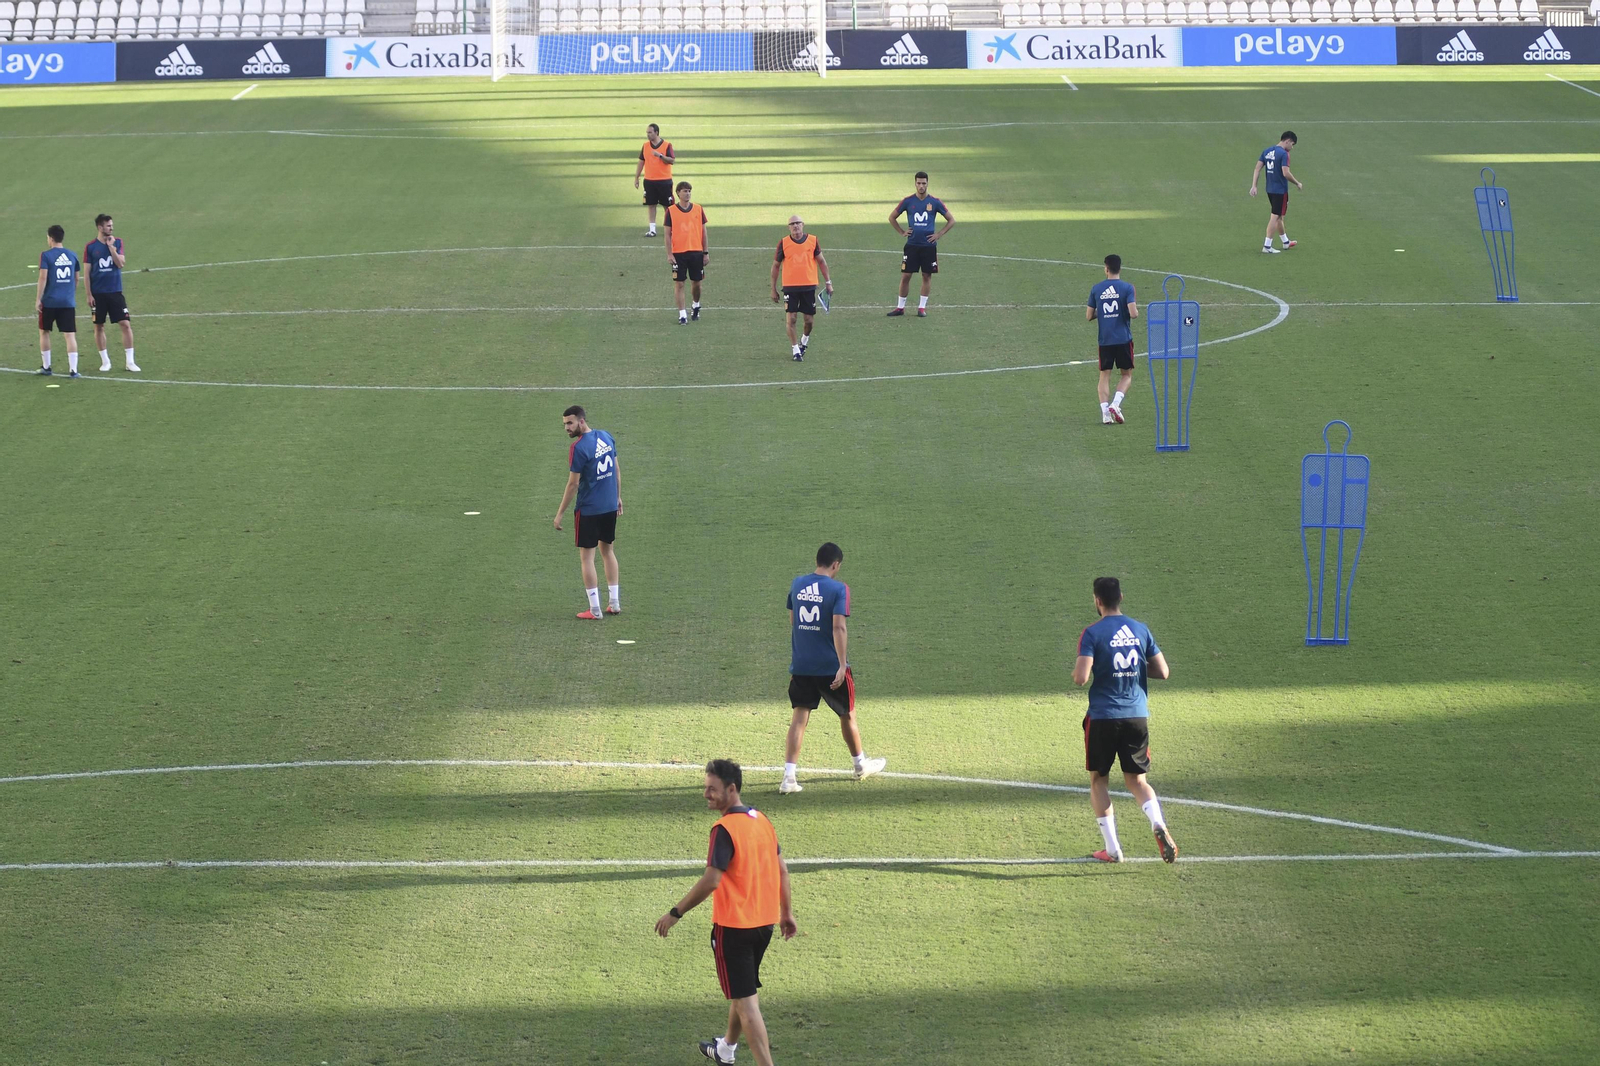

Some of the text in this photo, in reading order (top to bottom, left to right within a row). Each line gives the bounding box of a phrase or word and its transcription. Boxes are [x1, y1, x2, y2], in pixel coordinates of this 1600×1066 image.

[1026, 34, 1166, 60] CaixaBank
[880, 53, 928, 65] adidas
[1436, 50, 1484, 62] adidas
[1523, 49, 1571, 61] adidas
[155, 63, 203, 76] adidas
[242, 62, 290, 75] adidas
[796, 593, 823, 603] adidas
[1109, 637, 1140, 647] adidas
